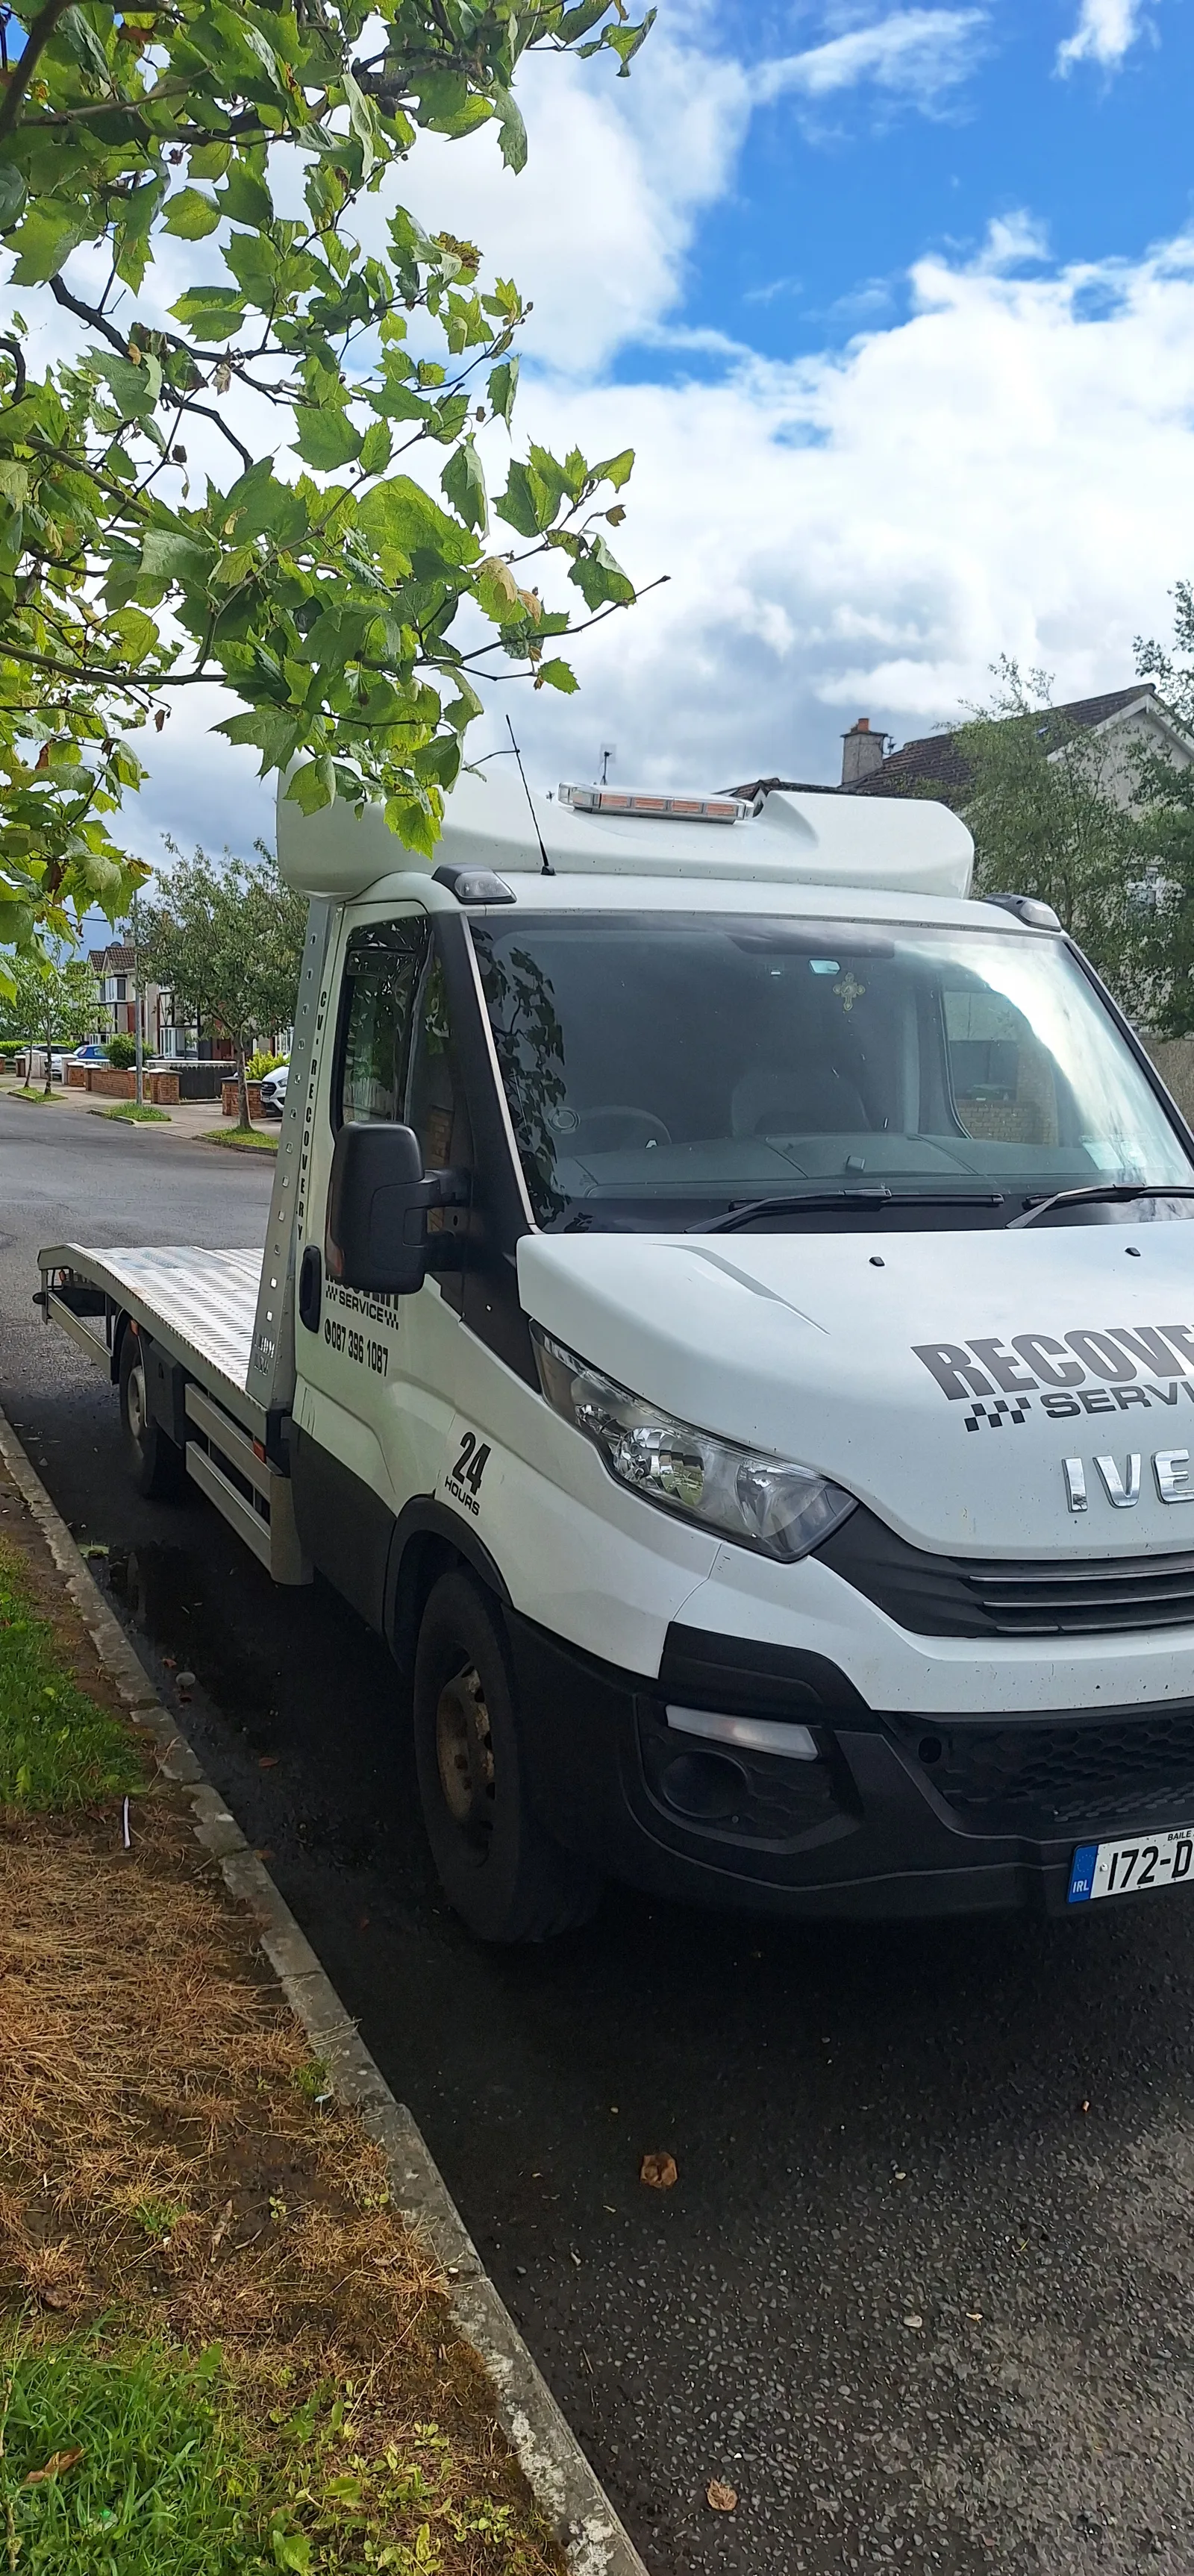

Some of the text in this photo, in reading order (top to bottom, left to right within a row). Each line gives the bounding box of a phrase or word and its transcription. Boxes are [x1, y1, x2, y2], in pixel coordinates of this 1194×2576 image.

[339, 1291, 384, 1323] SERVICE
[332, 1321, 389, 1377] 087 396 1087
[910, 1324, 1194, 1401] RECOVE
[451, 1431, 492, 1497] 24
[1061, 1449, 1194, 1514] IVE
[444, 1476, 481, 1516] HOURS
[1167, 1830, 1192, 1841] BAILE
[1072, 1839, 1193, 1893] IRL 172-D
